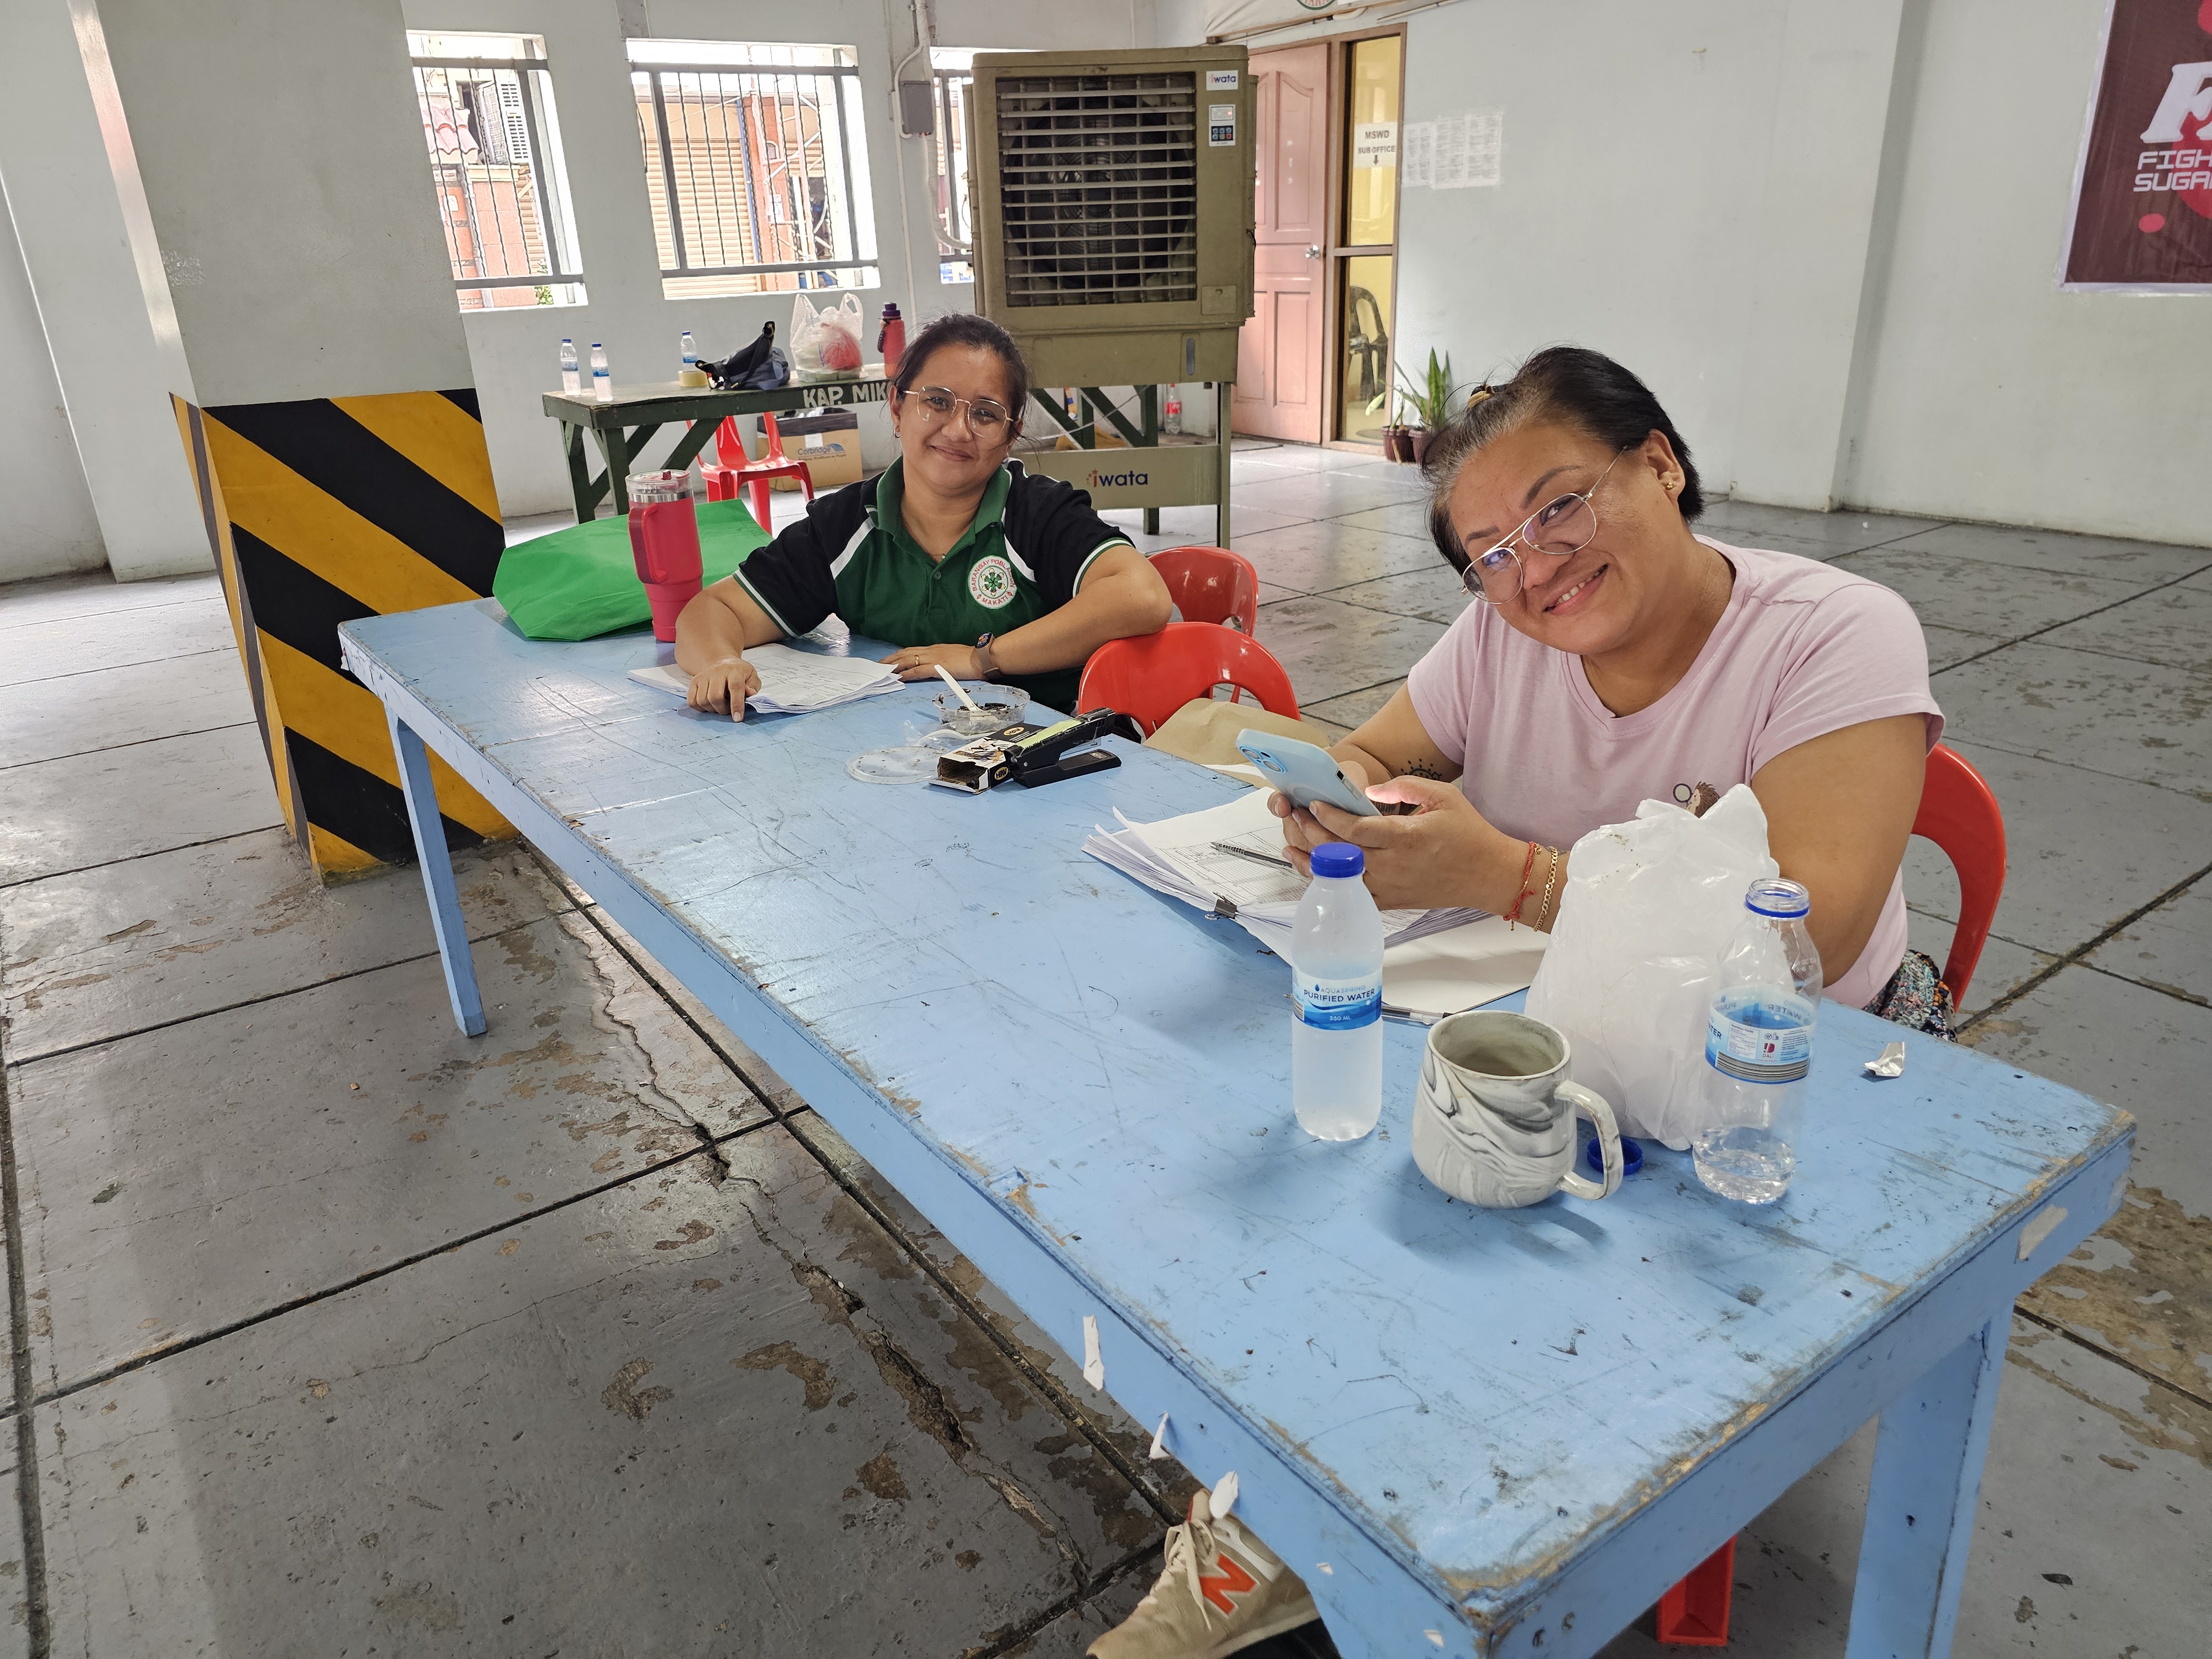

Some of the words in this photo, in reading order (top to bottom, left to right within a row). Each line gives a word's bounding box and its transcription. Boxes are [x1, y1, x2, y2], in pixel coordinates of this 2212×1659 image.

[1210, 74, 1237, 84] iwata
[1365, 130, 1390, 140] MSWD
[2133, 171, 2212, 192] SUGA
[802, 386, 844, 408] KAP.
[797, 446, 831, 455] Corbridge
[1092, 469, 1149, 488] iwata
[972, 560, 990, 592] BARANGAY
[982, 595, 1009, 606] MAKATI
[1303, 989, 1344, 1002] PURIFIED
[1347, 988, 1375, 1001] WATER
[1321, 984, 1366, 994] AQUASPRING
